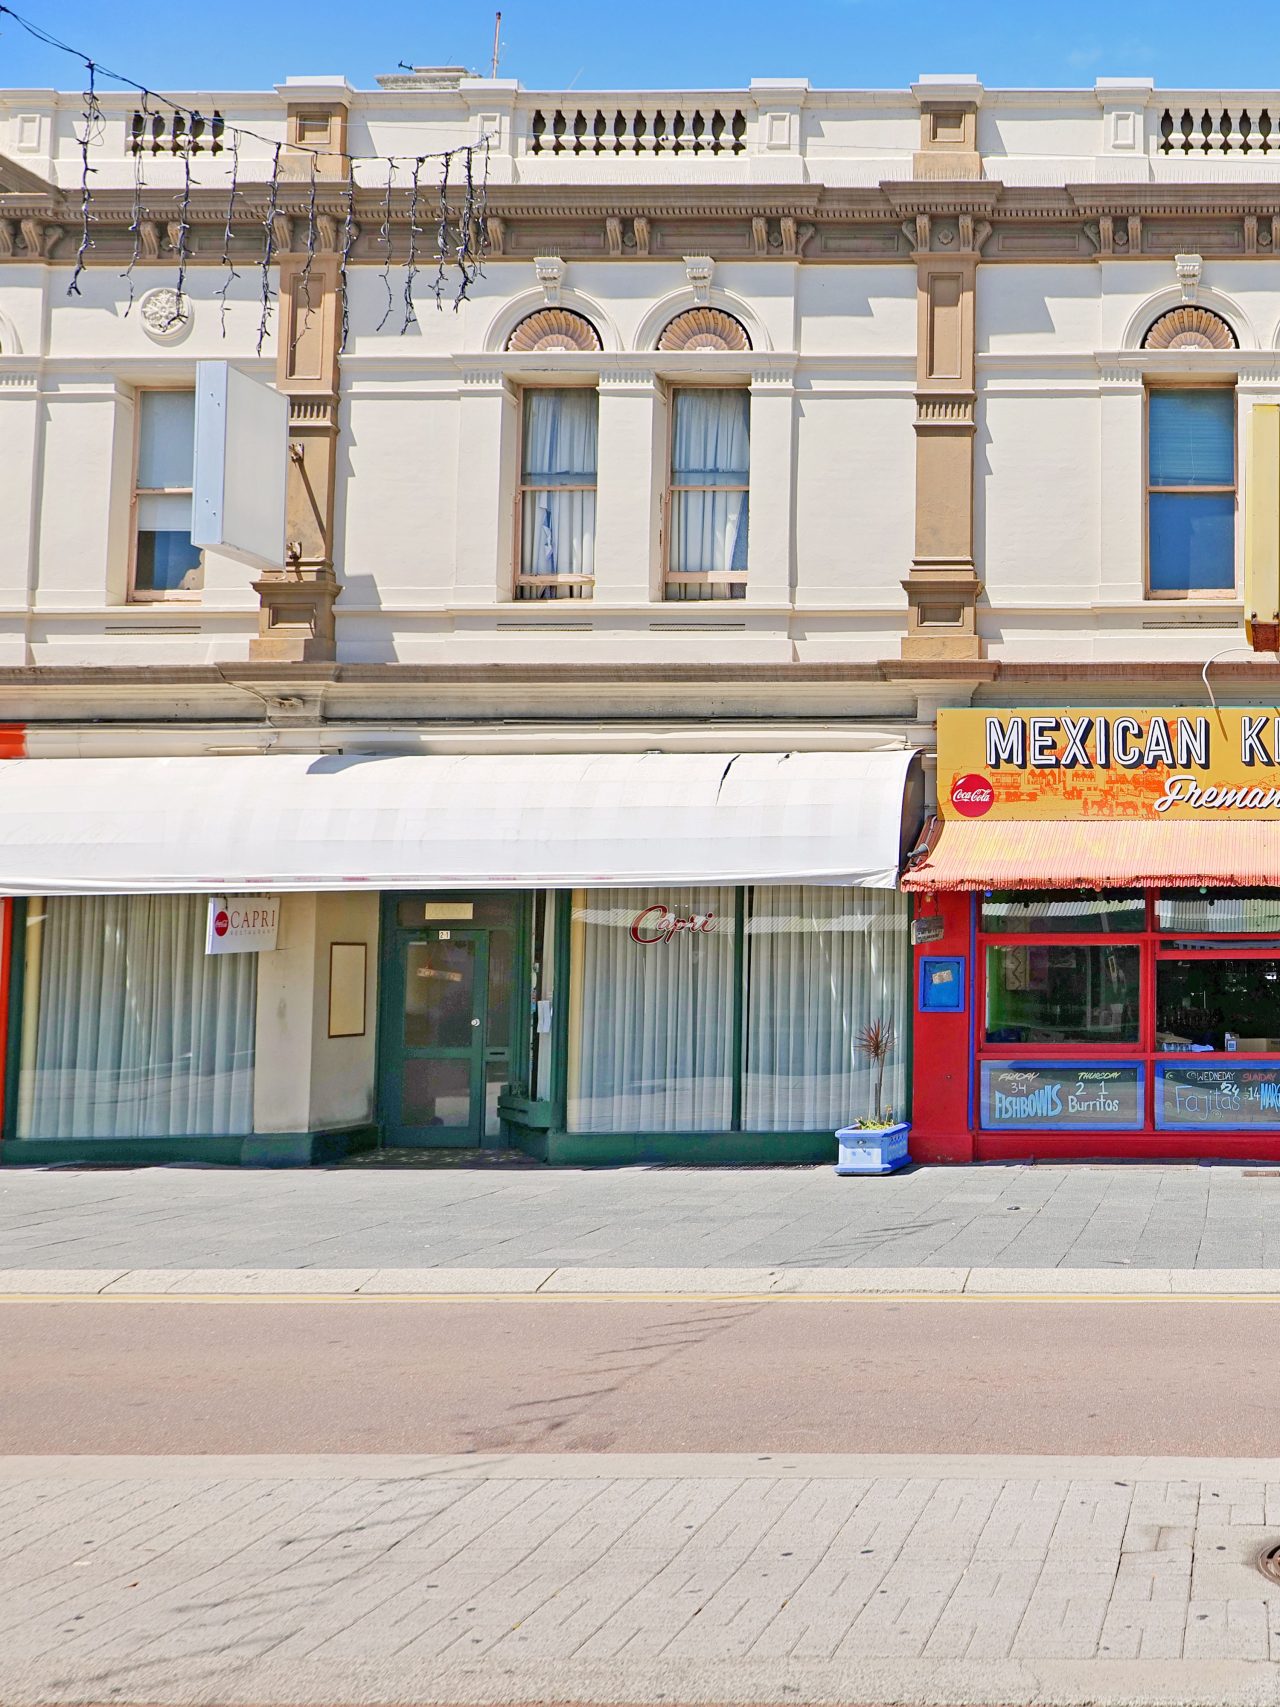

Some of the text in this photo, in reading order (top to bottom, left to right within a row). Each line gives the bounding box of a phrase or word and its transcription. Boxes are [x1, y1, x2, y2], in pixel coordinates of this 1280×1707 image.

[985, 716, 1211, 769] MEXICAN
[230, 909, 276, 929] CAPRI
[629, 904, 718, 945] Capri
[999, 1071, 1041, 1082] FRIDAY
[1076, 1071, 1122, 1081] THURSDAY
[1240, 1071, 1278, 1083] SUNDAY
[1067, 1095, 1120, 1113] Burritos
[1174, 1085, 1242, 1121] Fajitas
